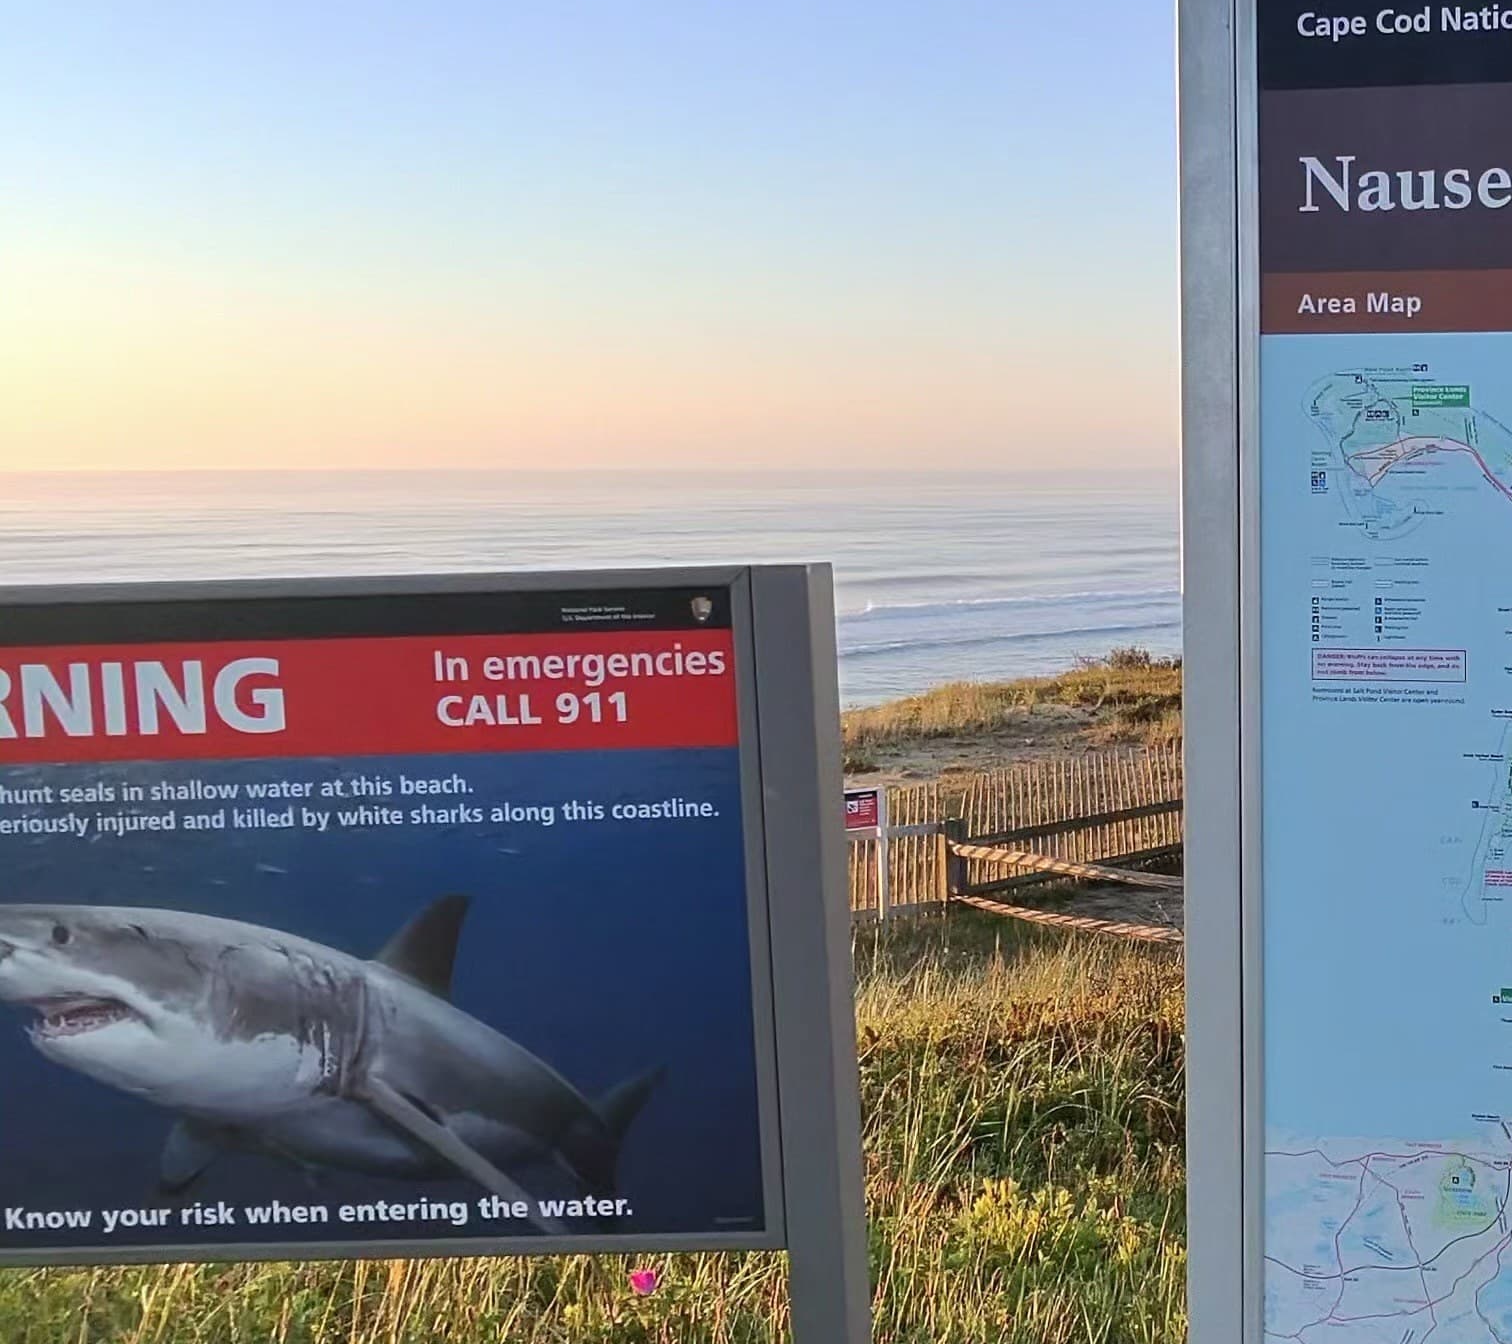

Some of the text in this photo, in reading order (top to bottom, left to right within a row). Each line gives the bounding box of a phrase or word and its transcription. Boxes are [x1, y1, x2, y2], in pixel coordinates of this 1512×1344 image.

[1297, 12, 1366, 41] Cape
[1376, 6, 1429, 33] Cod
[1298, 292, 1420, 317] Area Map
[434, 651, 724, 686] In emergencies
[437, 692, 626, 726] CALL 911
[60, 782, 114, 802] seals
[122, 782, 142, 800] in
[150, 780, 238, 800] shallow
[245, 781, 312, 797] water
[321, 778, 344, 798] at
[351, 776, 392, 797] this
[400, 774, 473, 794] beach.
[96, 809, 175, 835] injured
[183, 809, 224, 829] and
[233, 806, 294, 827] killed
[302, 807, 329, 831] by
[337, 806, 402, 825] white
[410, 803, 482, 823] sharks
[491, 802, 554, 825] along
[561, 800, 604, 820] this
[612, 798, 718, 818] coastline.
[5, 1195, 632, 1232] Know your risk when entering the water.
